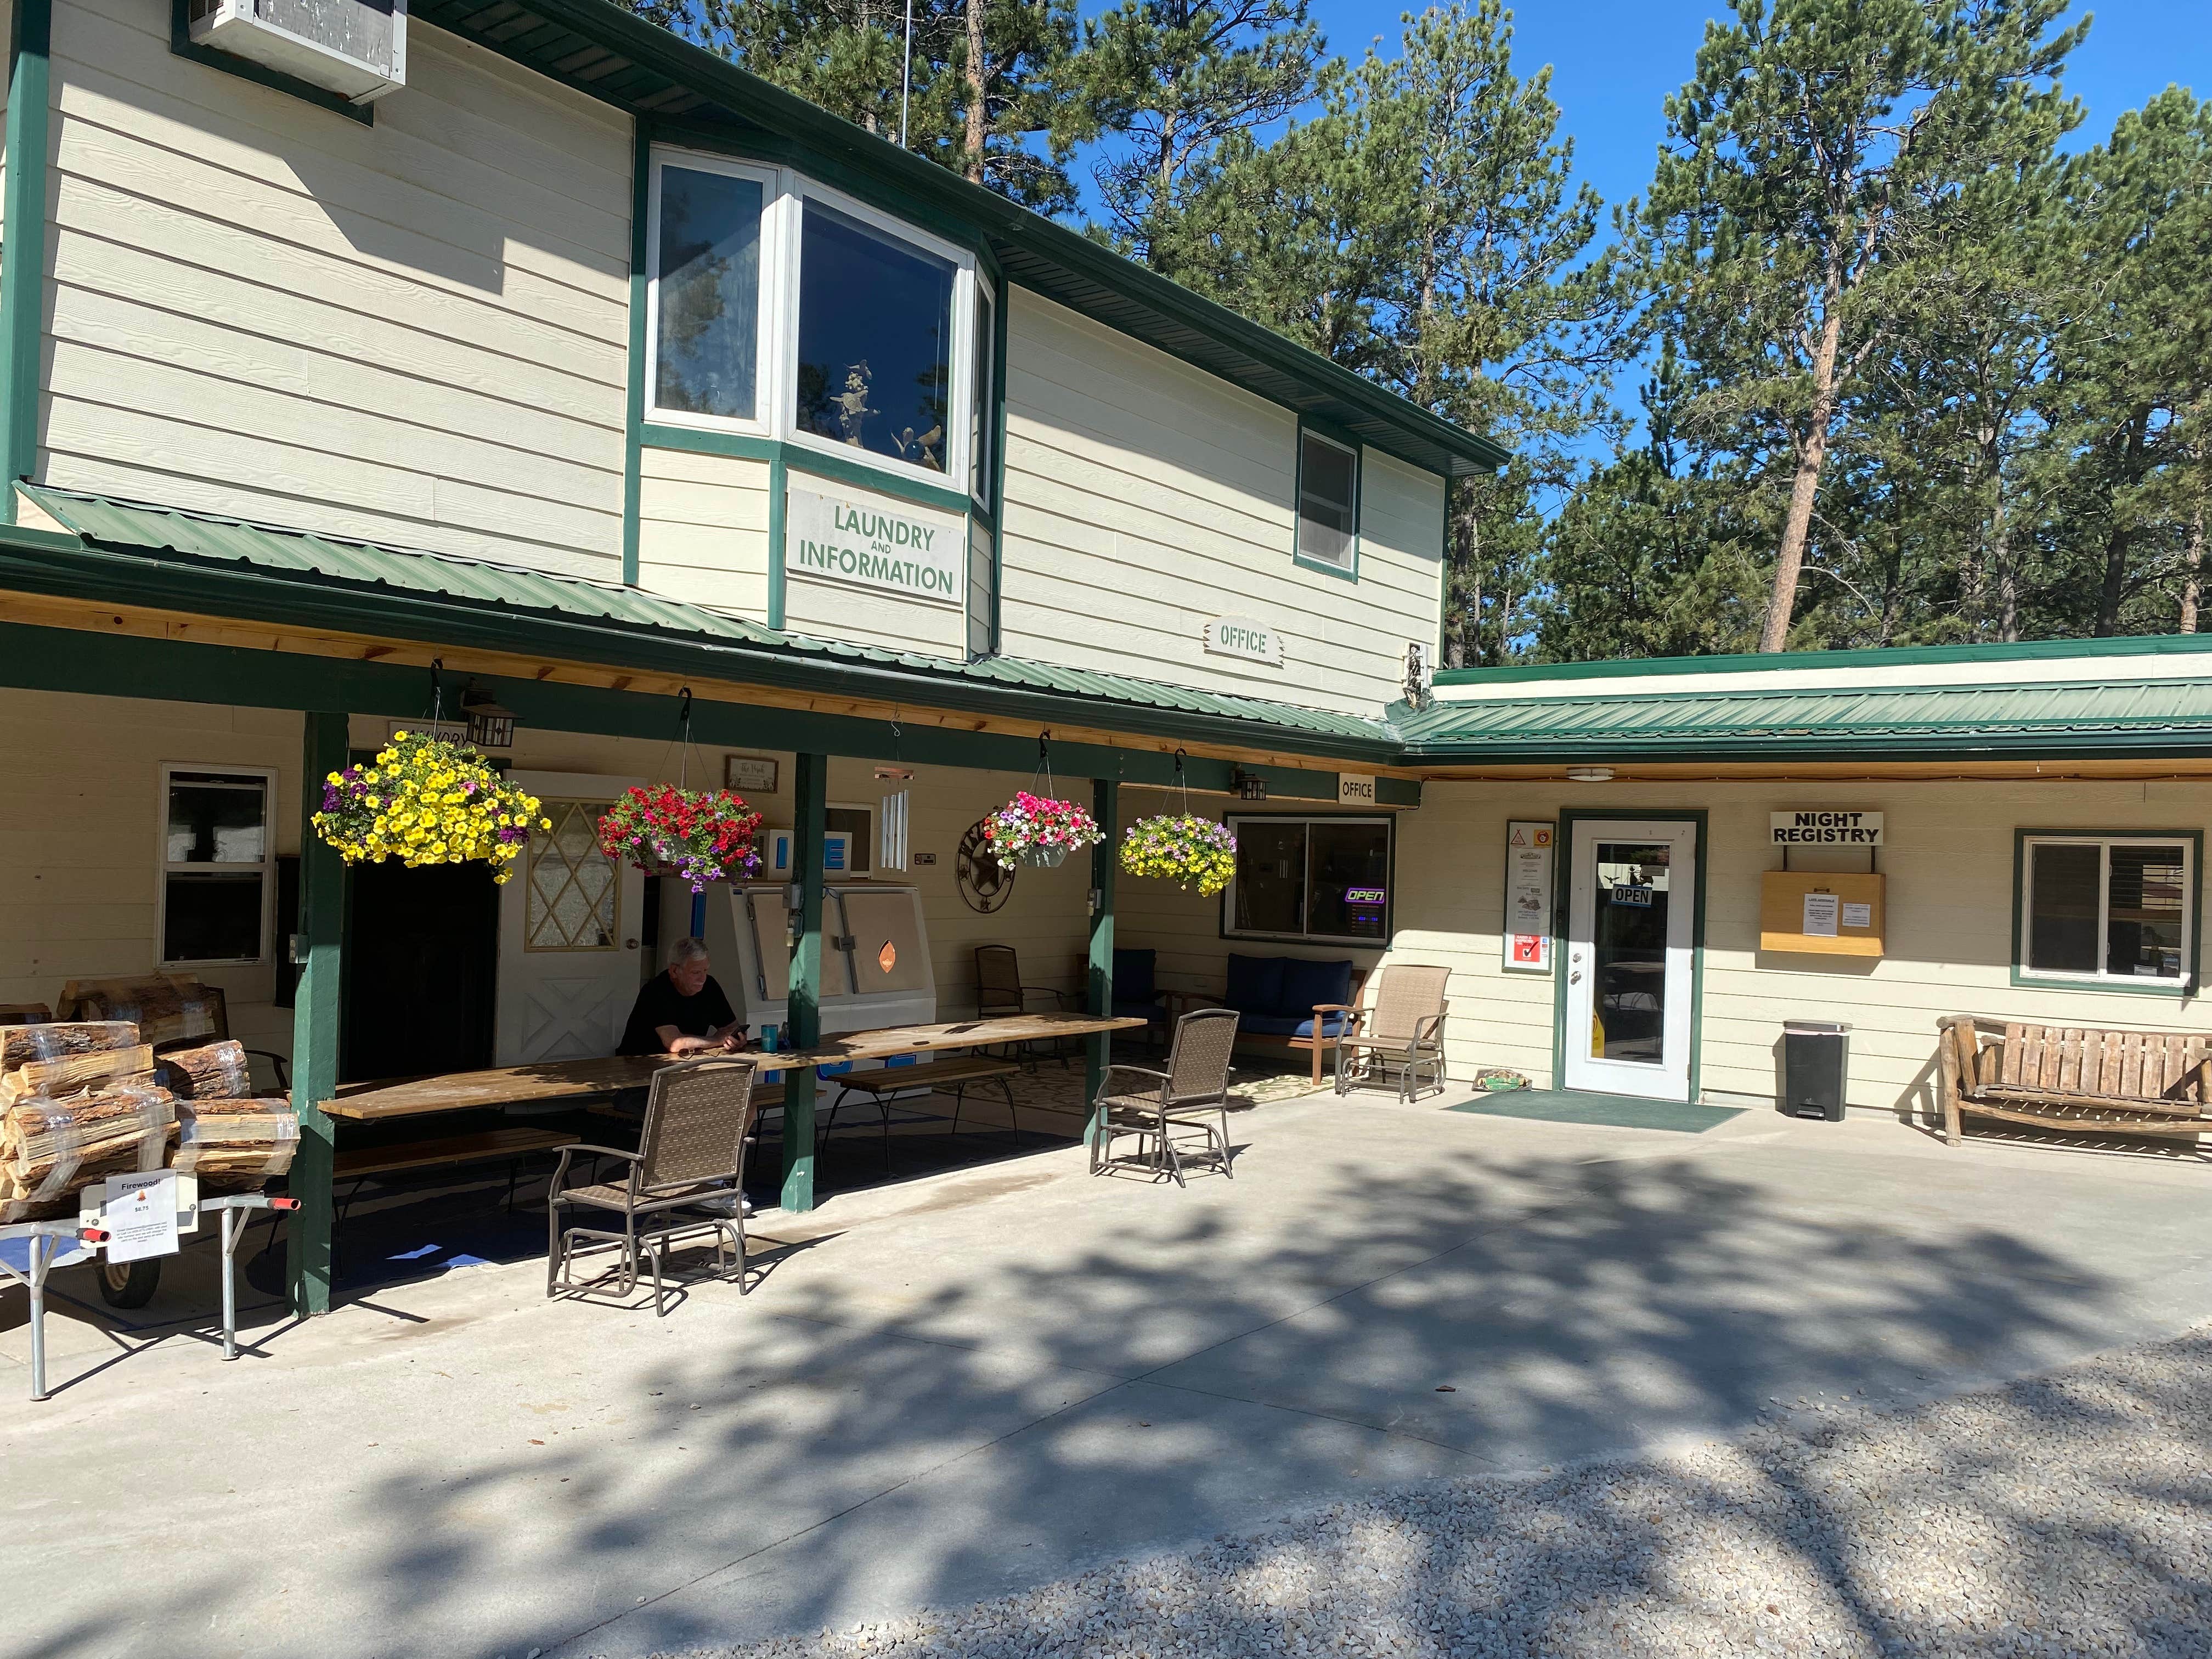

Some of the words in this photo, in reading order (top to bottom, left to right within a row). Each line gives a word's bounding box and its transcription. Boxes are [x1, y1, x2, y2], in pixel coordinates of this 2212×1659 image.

[834, 505, 935, 551] LAUNDRY
[871, 540, 891, 554] AND
[800, 539, 952, 594] INFORMATION
[1221, 625, 1267, 654] OFFICE
[1342, 781, 1372, 798] OFFICE
[1795, 812, 1862, 827] NIGHT
[1774, 828, 1879, 842] REGISTRY
[1347, 890, 1384, 901] OPEN
[1615, 888, 1649, 903] OPEN
[121, 1178, 161, 1190] Firewood!
